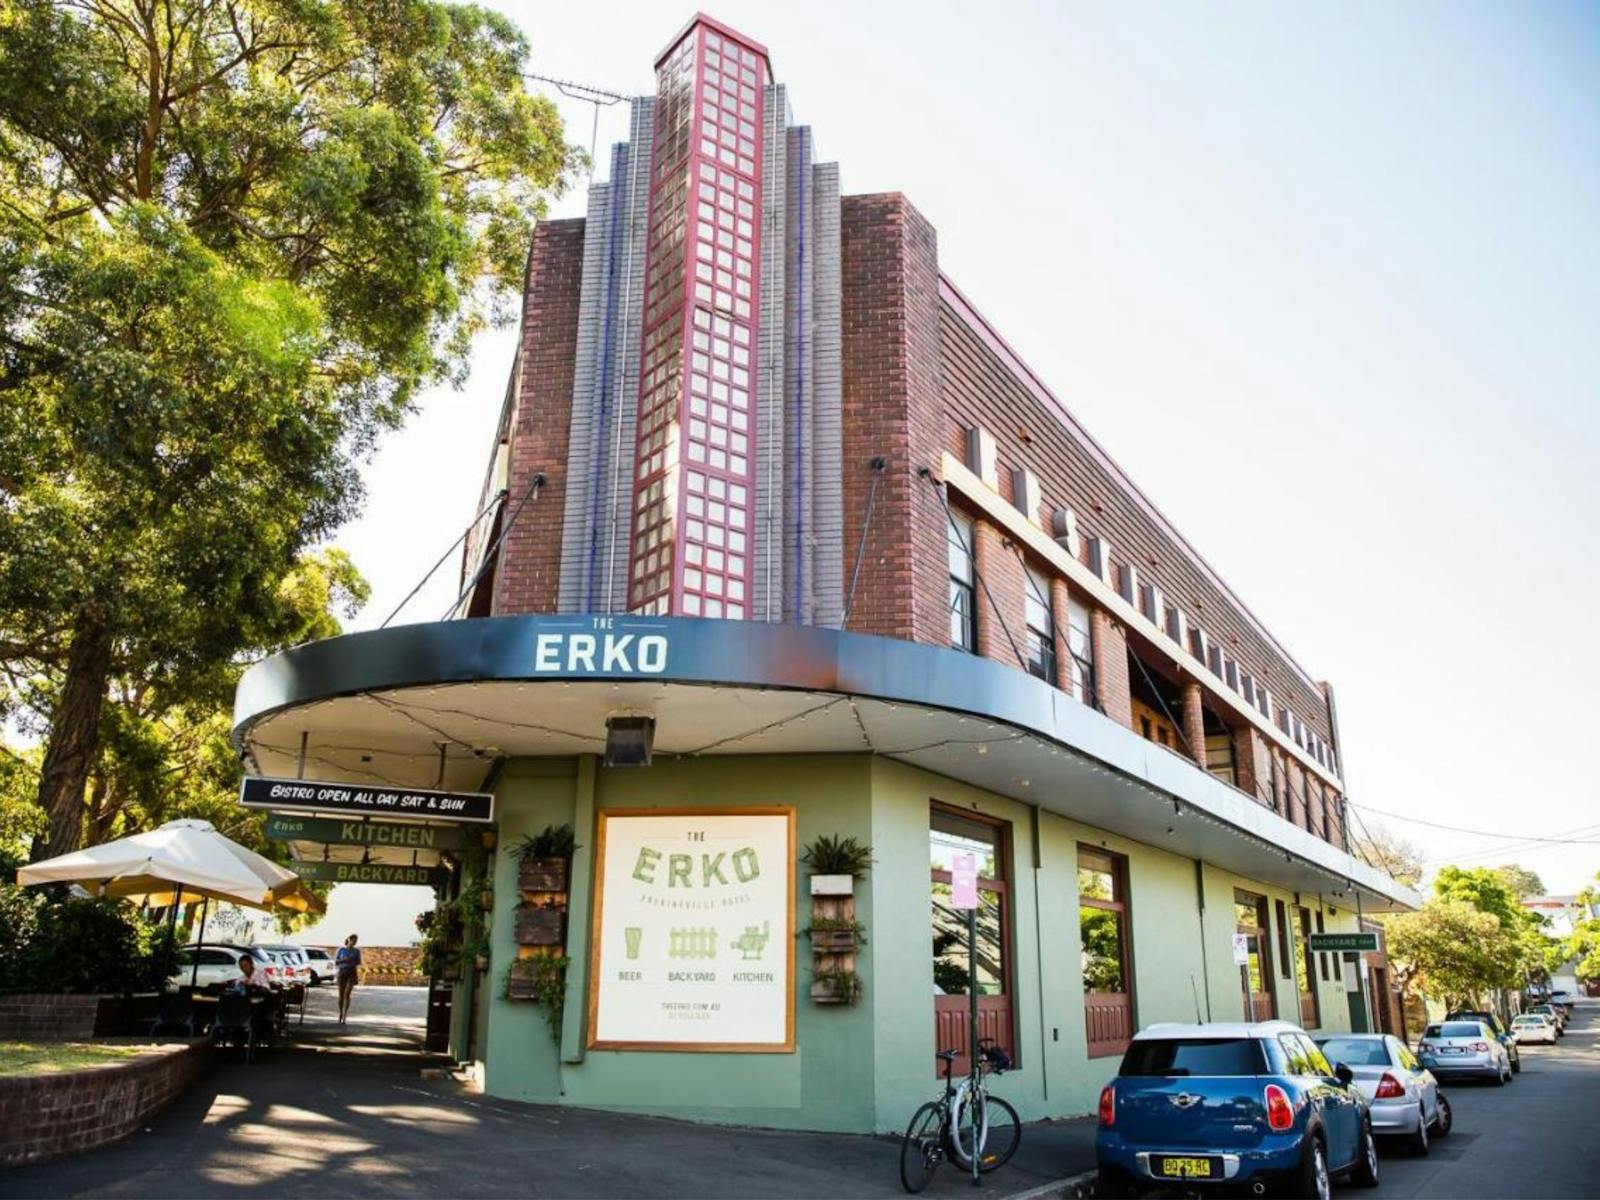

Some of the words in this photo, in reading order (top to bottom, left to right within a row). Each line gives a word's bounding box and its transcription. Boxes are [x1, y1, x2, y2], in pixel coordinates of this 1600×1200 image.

[593, 617, 614, 630] THE
[534, 634, 668, 674] ERKO
[270, 784, 315, 799] BISTRO
[317, 788, 351, 803] OPEN
[354, 792, 374, 805] ALL
[375, 793, 399, 806] DAY
[400, 795, 425, 808] SAT
[427, 797, 437, 809] &
[439, 798, 466, 810] SUN
[341, 822, 435, 846] KITCHEN
[337, 865, 429, 883] BACKYARD
[632, 846, 761, 889] ERKO
[618, 970, 642, 982] BEER
[667, 971, 717, 982] BACKYARD
[732, 971, 774, 983] KITCHEN
